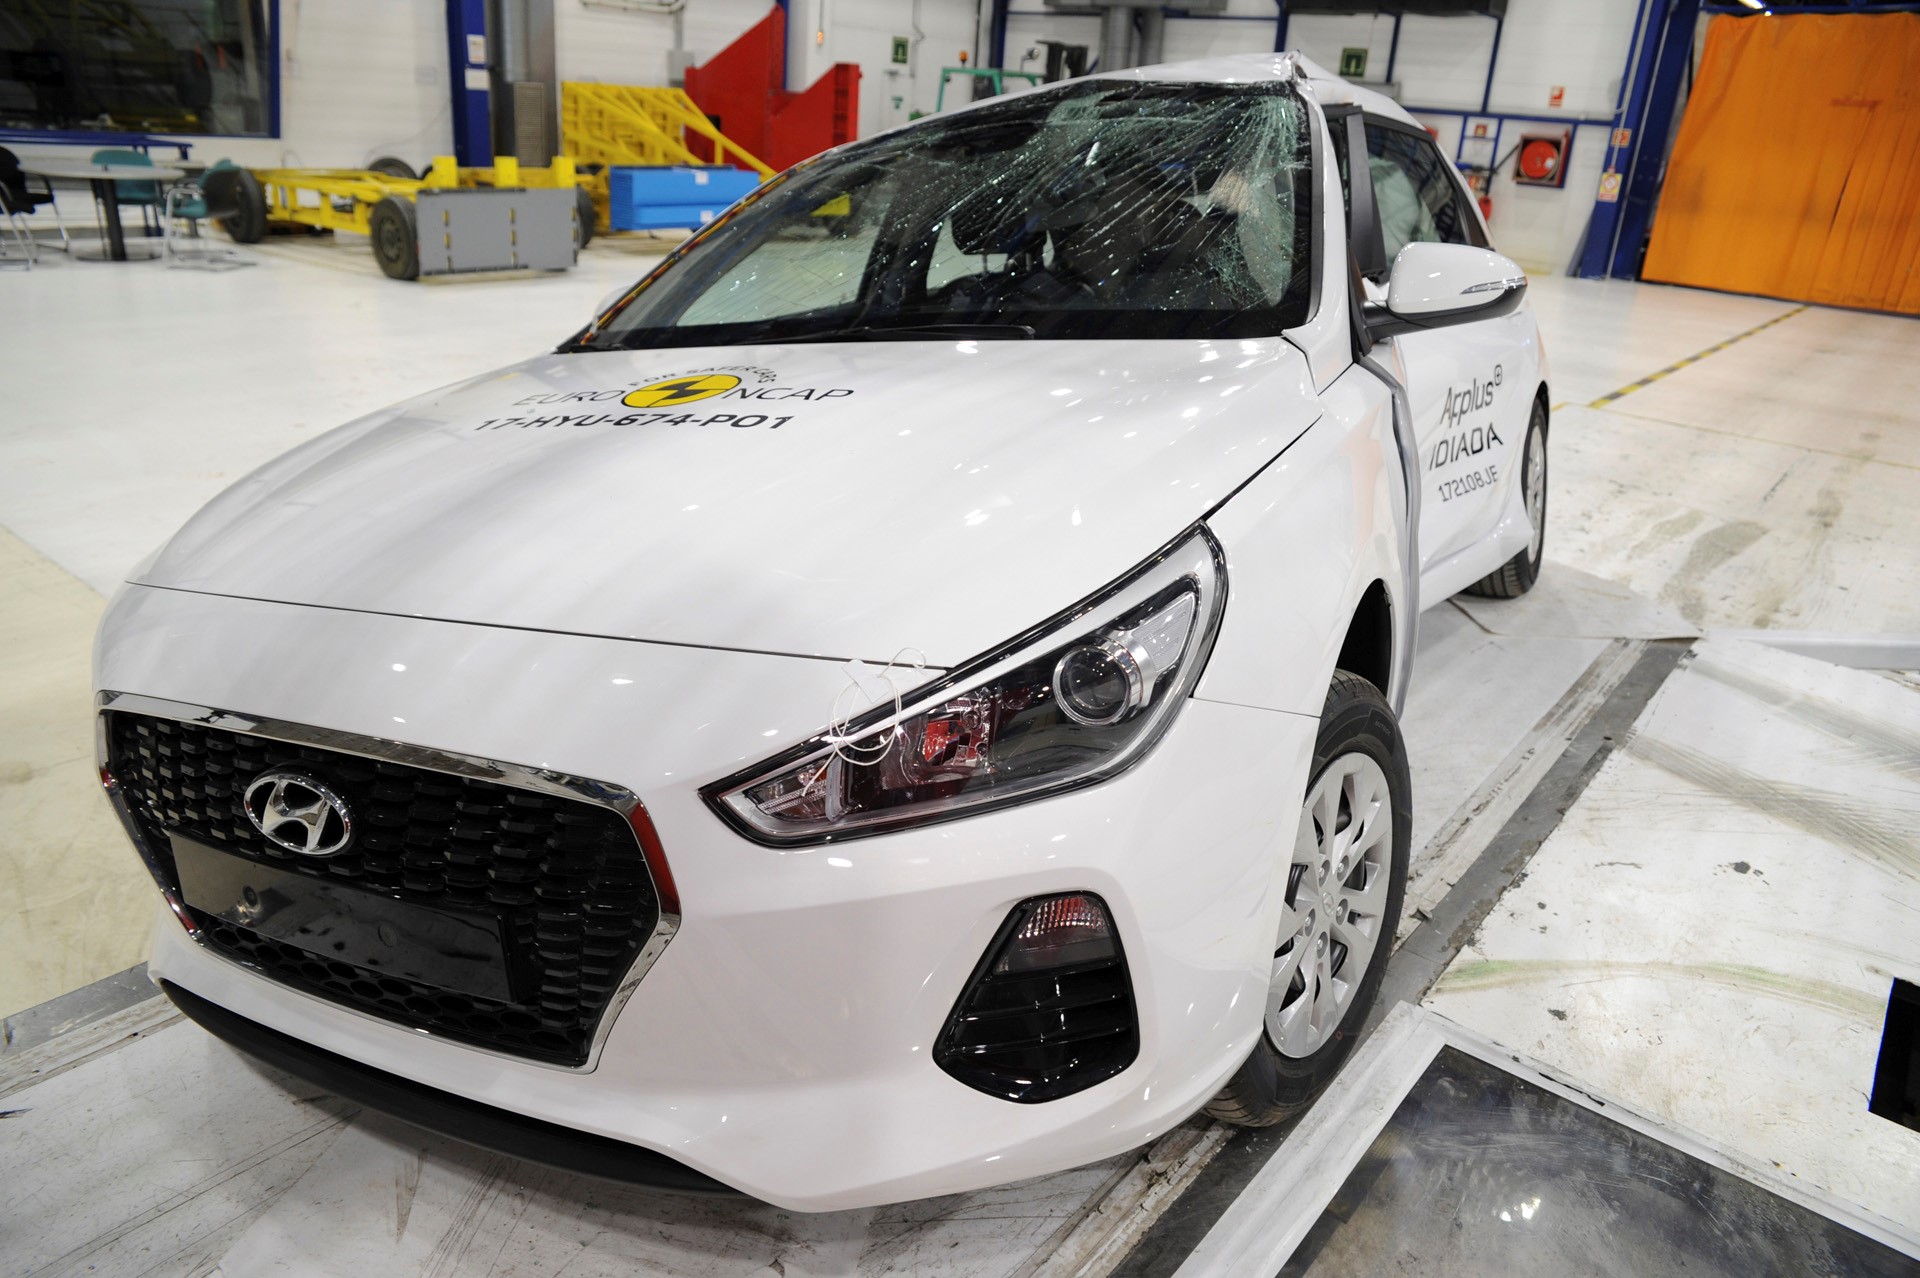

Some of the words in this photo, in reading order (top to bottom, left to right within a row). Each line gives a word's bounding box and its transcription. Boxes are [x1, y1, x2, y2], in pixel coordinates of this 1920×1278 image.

[628, 373, 677, 386] FOR
[686, 366, 758, 375] SAFER
[512, 389, 627, 406] EURO
[721, 387, 855, 401] NCAP
[1429, 422, 1504, 471] IDIADA
